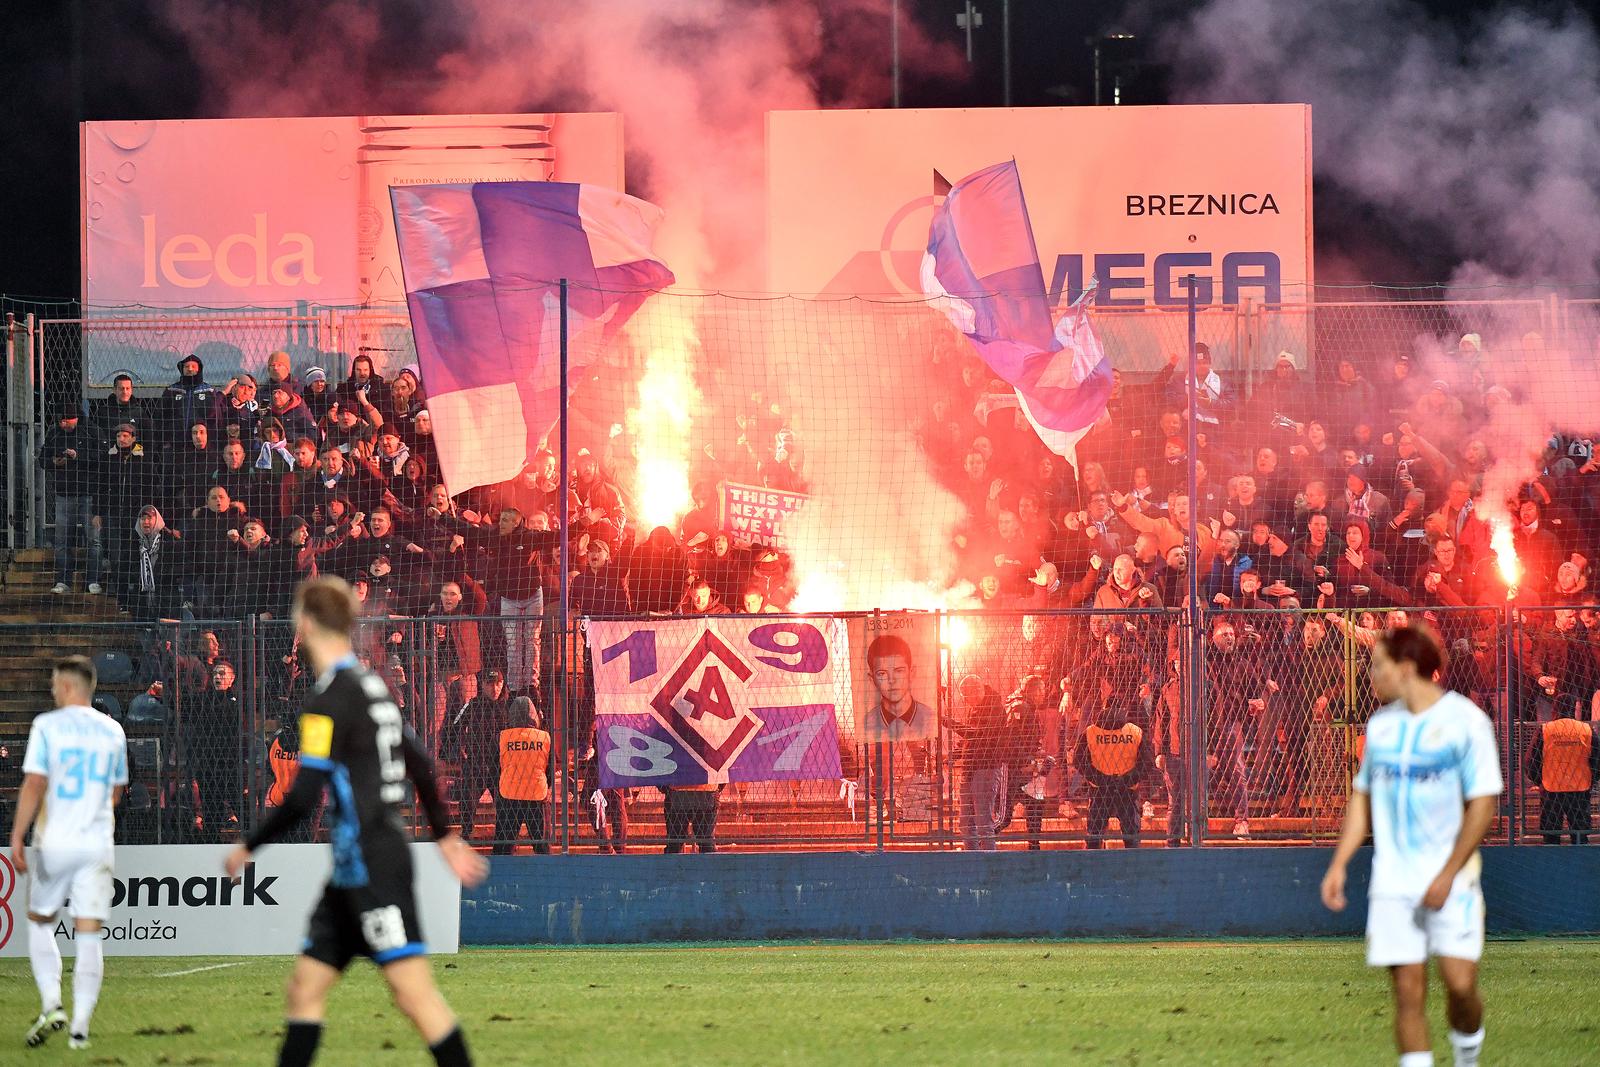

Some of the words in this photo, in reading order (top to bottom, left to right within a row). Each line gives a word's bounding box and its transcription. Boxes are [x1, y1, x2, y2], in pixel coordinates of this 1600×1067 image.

[1126, 194, 1280, 216] BREZNICA
[140, 211, 322, 288] leda
[730, 488, 778, 506] THIS
[730, 503, 778, 520] NEXT
[731, 516, 785, 536] WE'L
[866, 618, 914, 631] 1989-2011
[748, 622, 829, 674] 9
[507, 741, 543, 751] REDAR
[1096, 734, 1133, 744] REDAR
[606, 724, 678, 777] 8
[57, 747, 114, 800] 34
[54, 917, 177, 940] Aalaža
